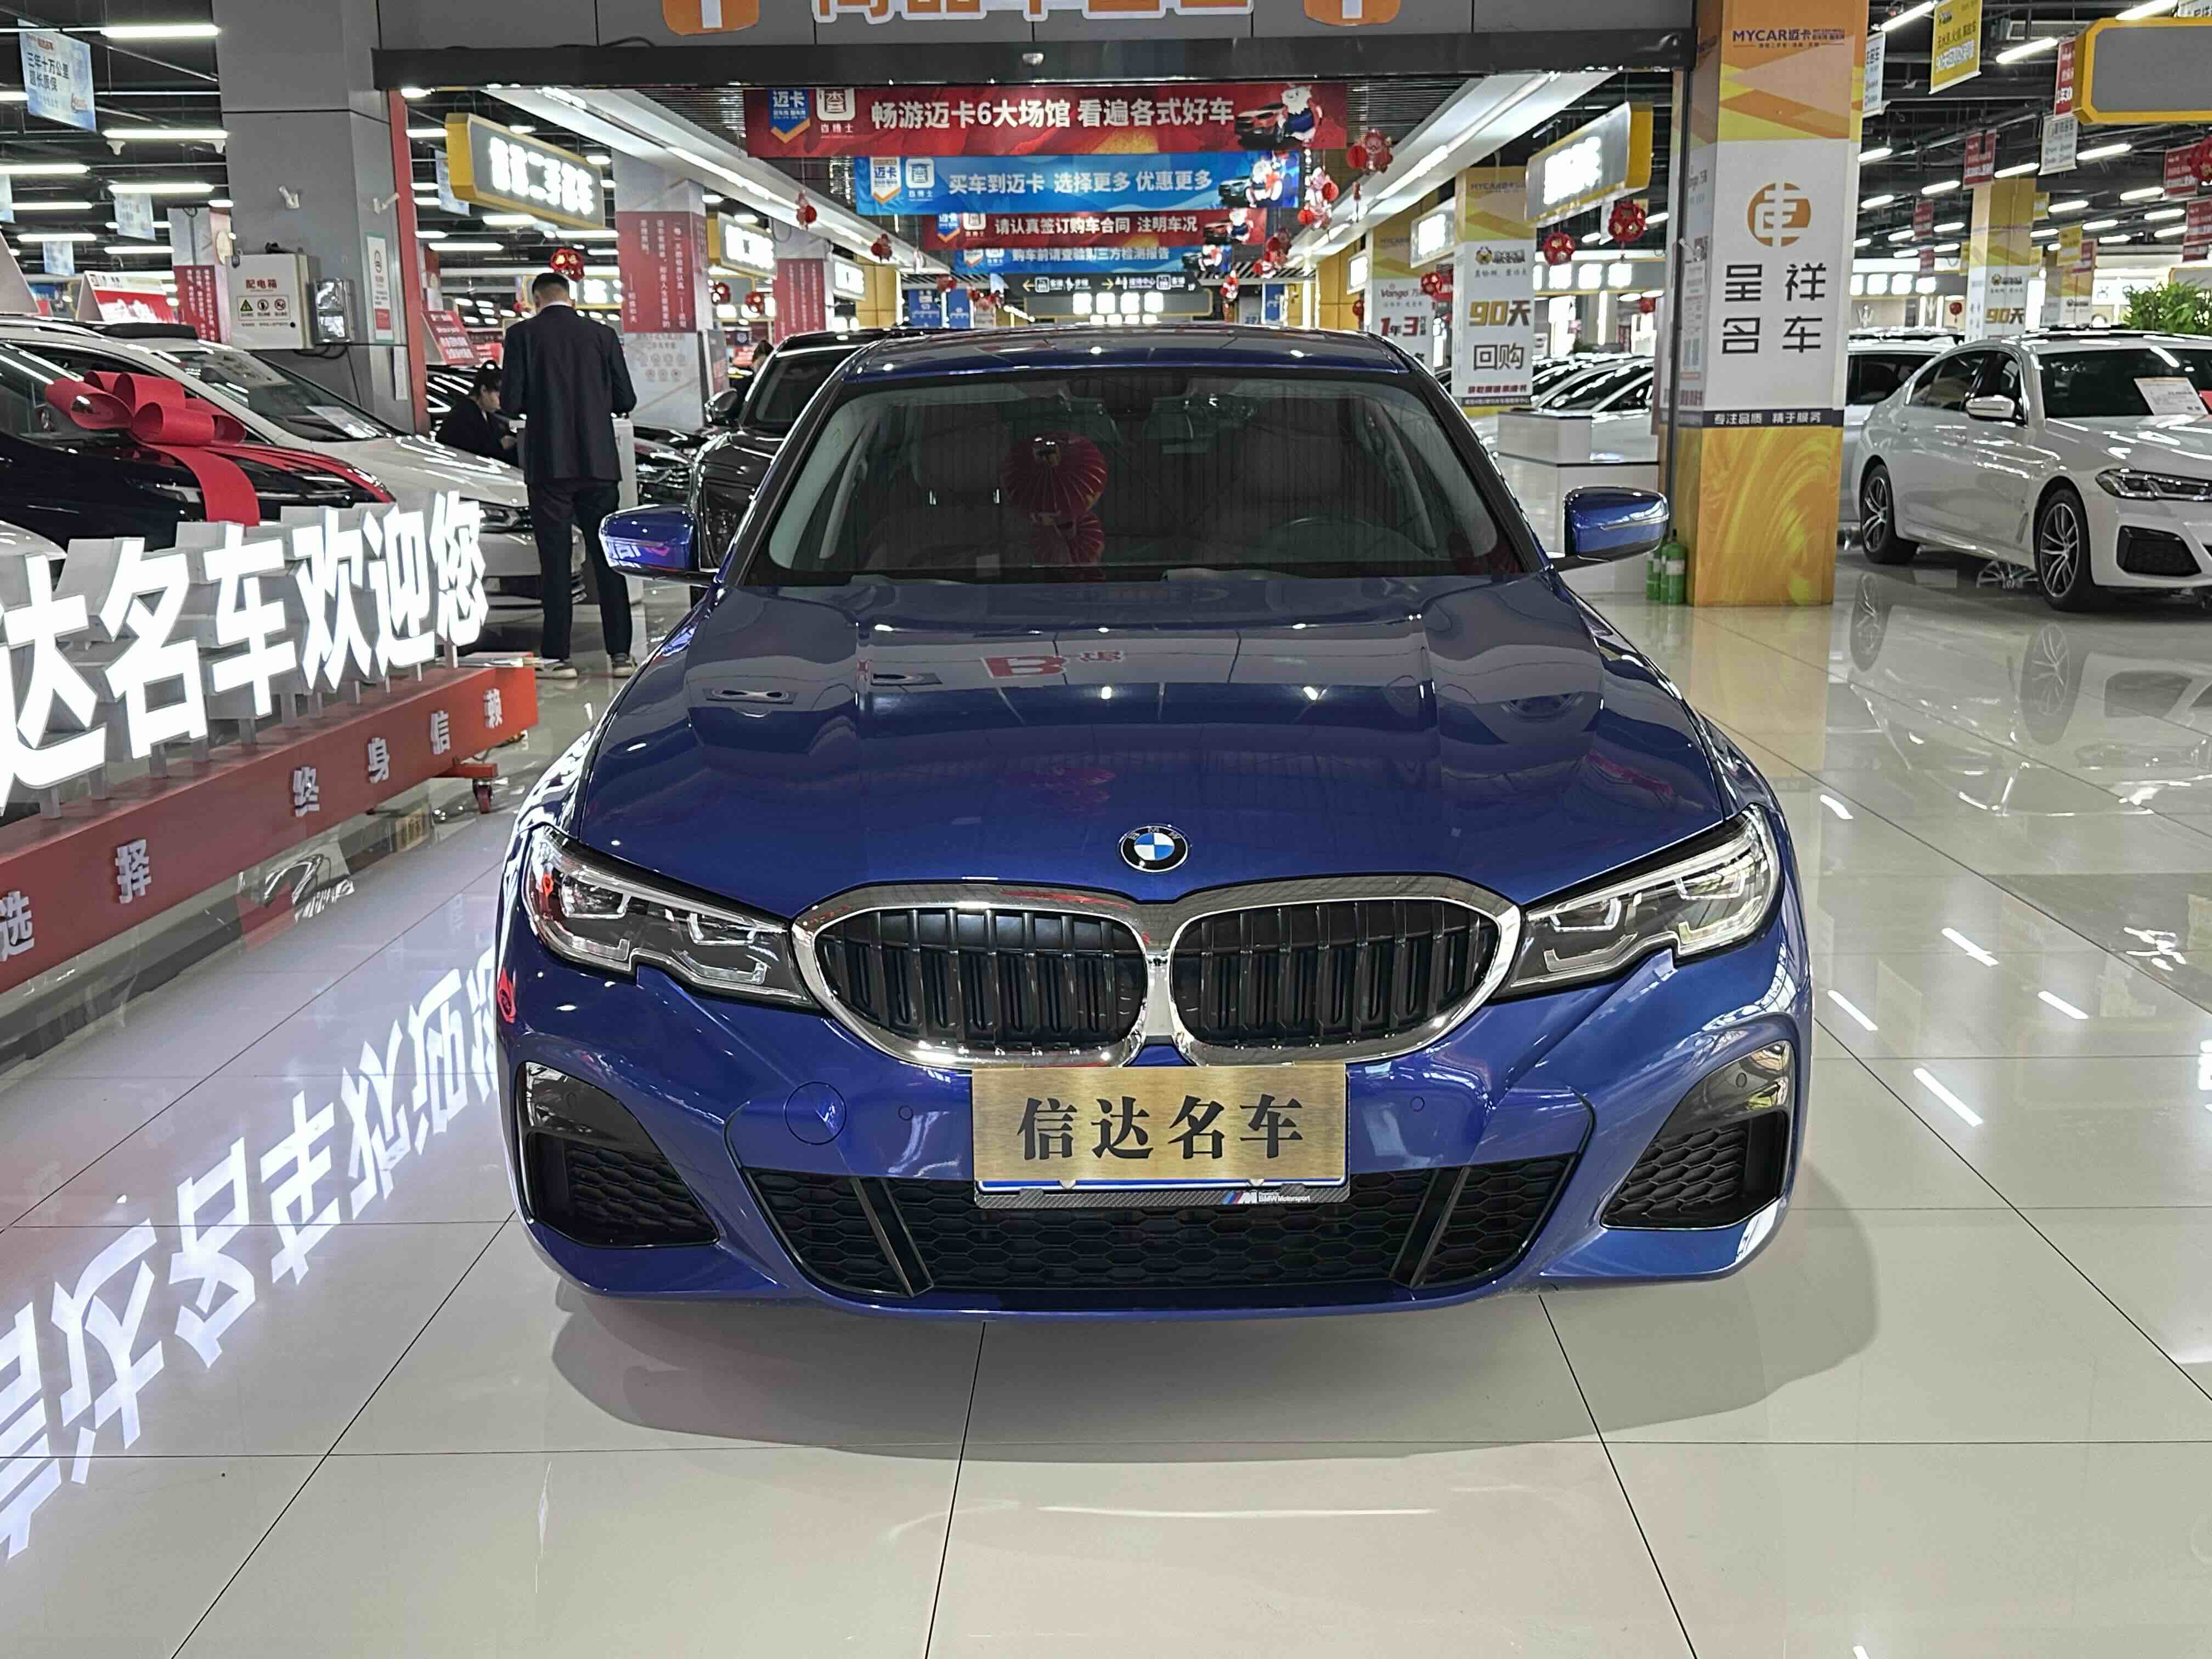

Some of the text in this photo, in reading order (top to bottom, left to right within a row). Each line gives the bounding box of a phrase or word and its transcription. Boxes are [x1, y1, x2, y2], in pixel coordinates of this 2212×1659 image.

[772, 90, 805, 109] 迈卡
[871, 97, 1234, 129] 畅游迈卡6大场馆 看遍各式好车
[874, 166, 897, 179] 迈卡
[948, 170, 1212, 195] 买车到迈卡 选择更多 优惠更多
[995, 216, 1199, 235] 请认真签订购车合同 注明车况
[245, 278, 278, 290] 配电箱
[1724, 262, 1827, 303] 呈祥
[1469, 300, 1531, 327] 90天
[1984, 307, 2025, 325] 90天
[1722, 314, 1824, 355] 名车
[1473, 342, 1525, 371] 回购
[1713, 411, 1822, 425] 专注品质 精于服务
[0, 489, 489, 816] 达名车欢迎您
[291, 687, 503, 817] 终身信赖
[1017, 1093, 1304, 1160] 信达名车
